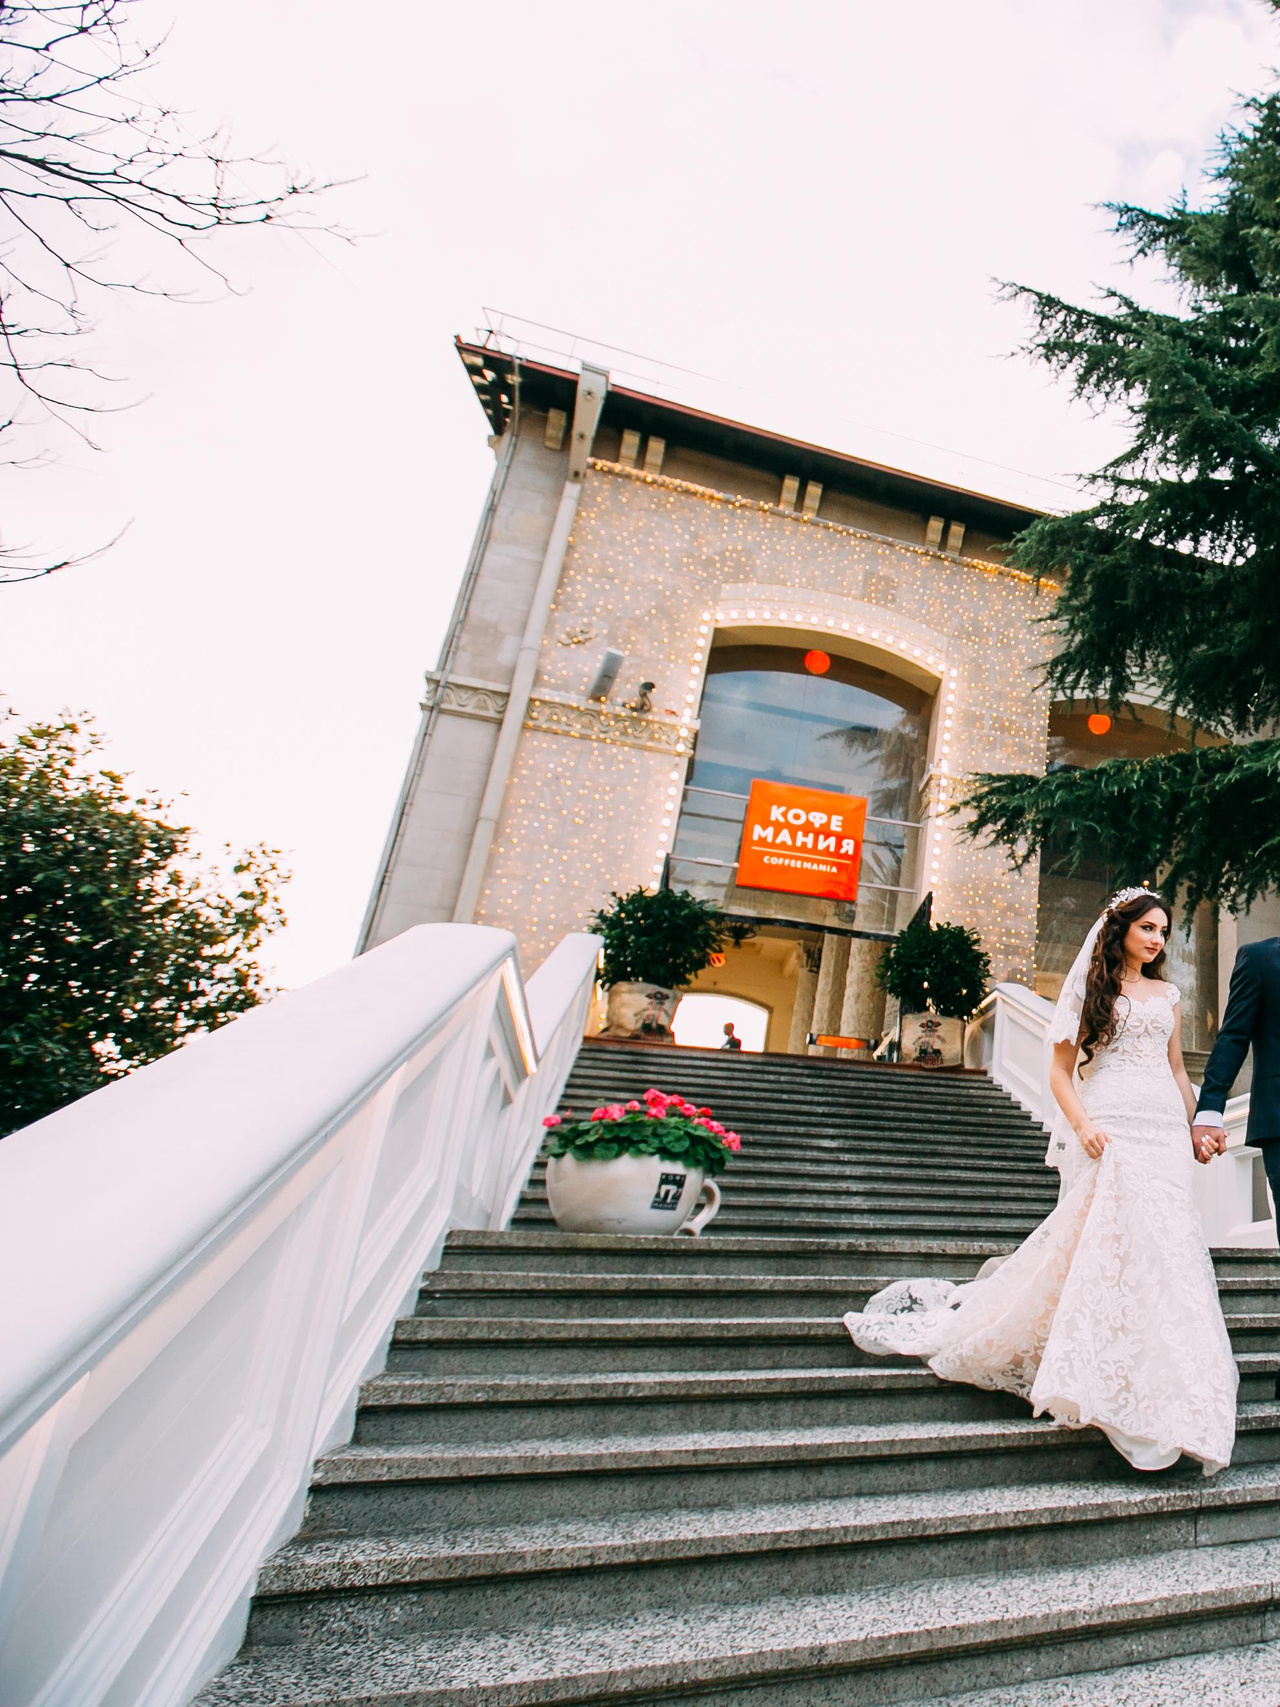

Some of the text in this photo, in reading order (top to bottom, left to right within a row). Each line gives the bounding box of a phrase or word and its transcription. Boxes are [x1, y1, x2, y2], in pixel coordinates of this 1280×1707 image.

[770, 805, 843, 832] КОФЕ
[752, 824, 855, 855] МАНИЯ
[763, 856, 838, 873] COFFEEMANIA
